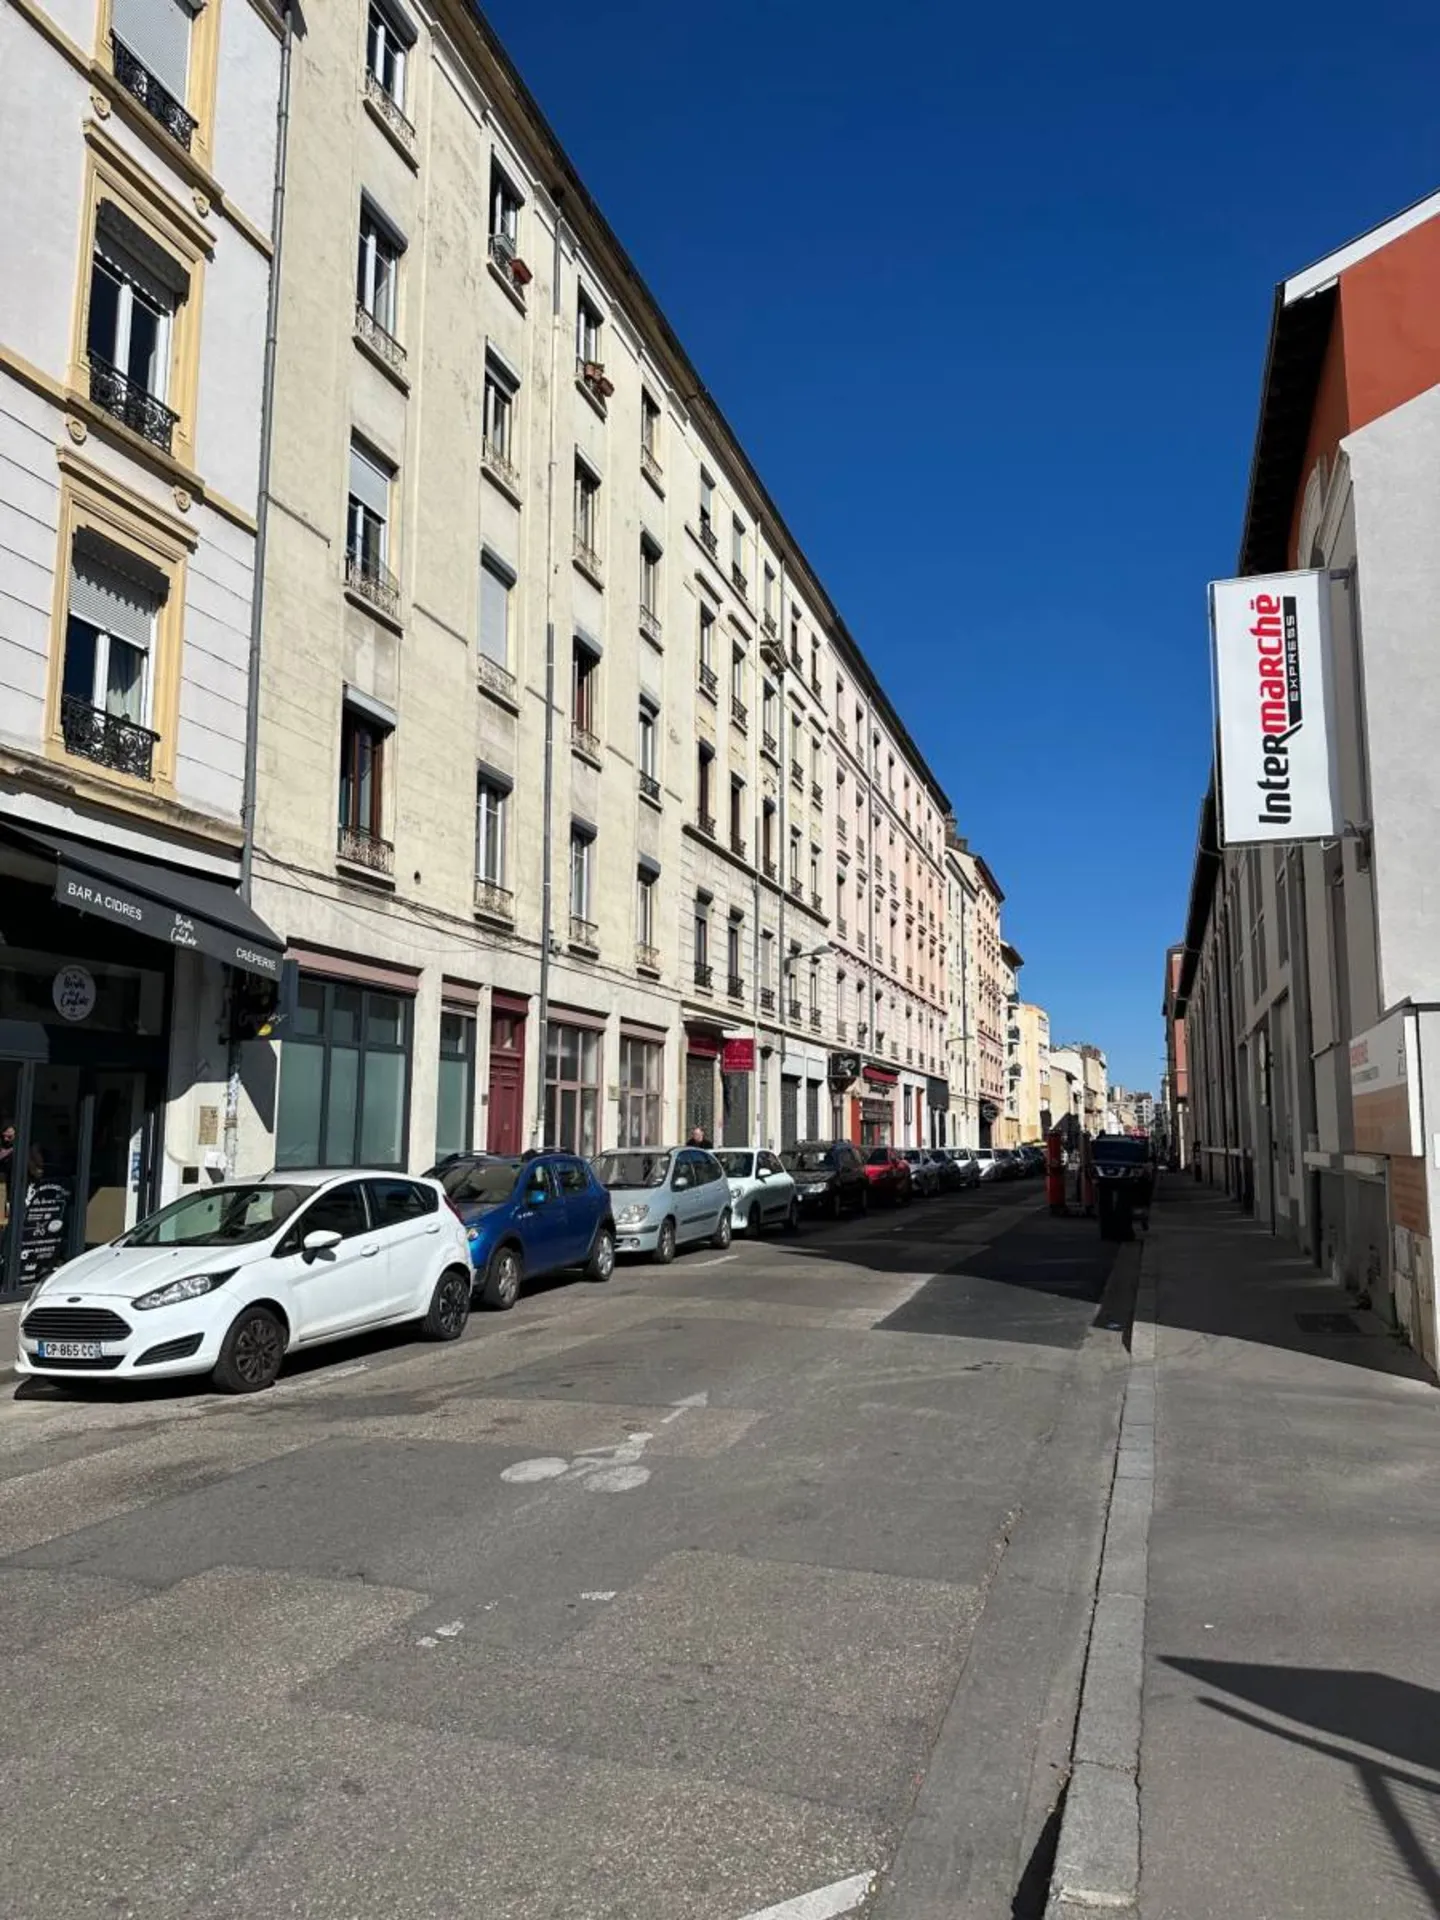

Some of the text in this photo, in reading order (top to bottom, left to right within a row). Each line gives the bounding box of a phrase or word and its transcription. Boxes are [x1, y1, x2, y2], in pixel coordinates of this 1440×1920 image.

[1286, 614, 1299, 702] EXPRESS
[67, 882, 92, 902] BAR
[105, 896, 142, 921] CIDRES
